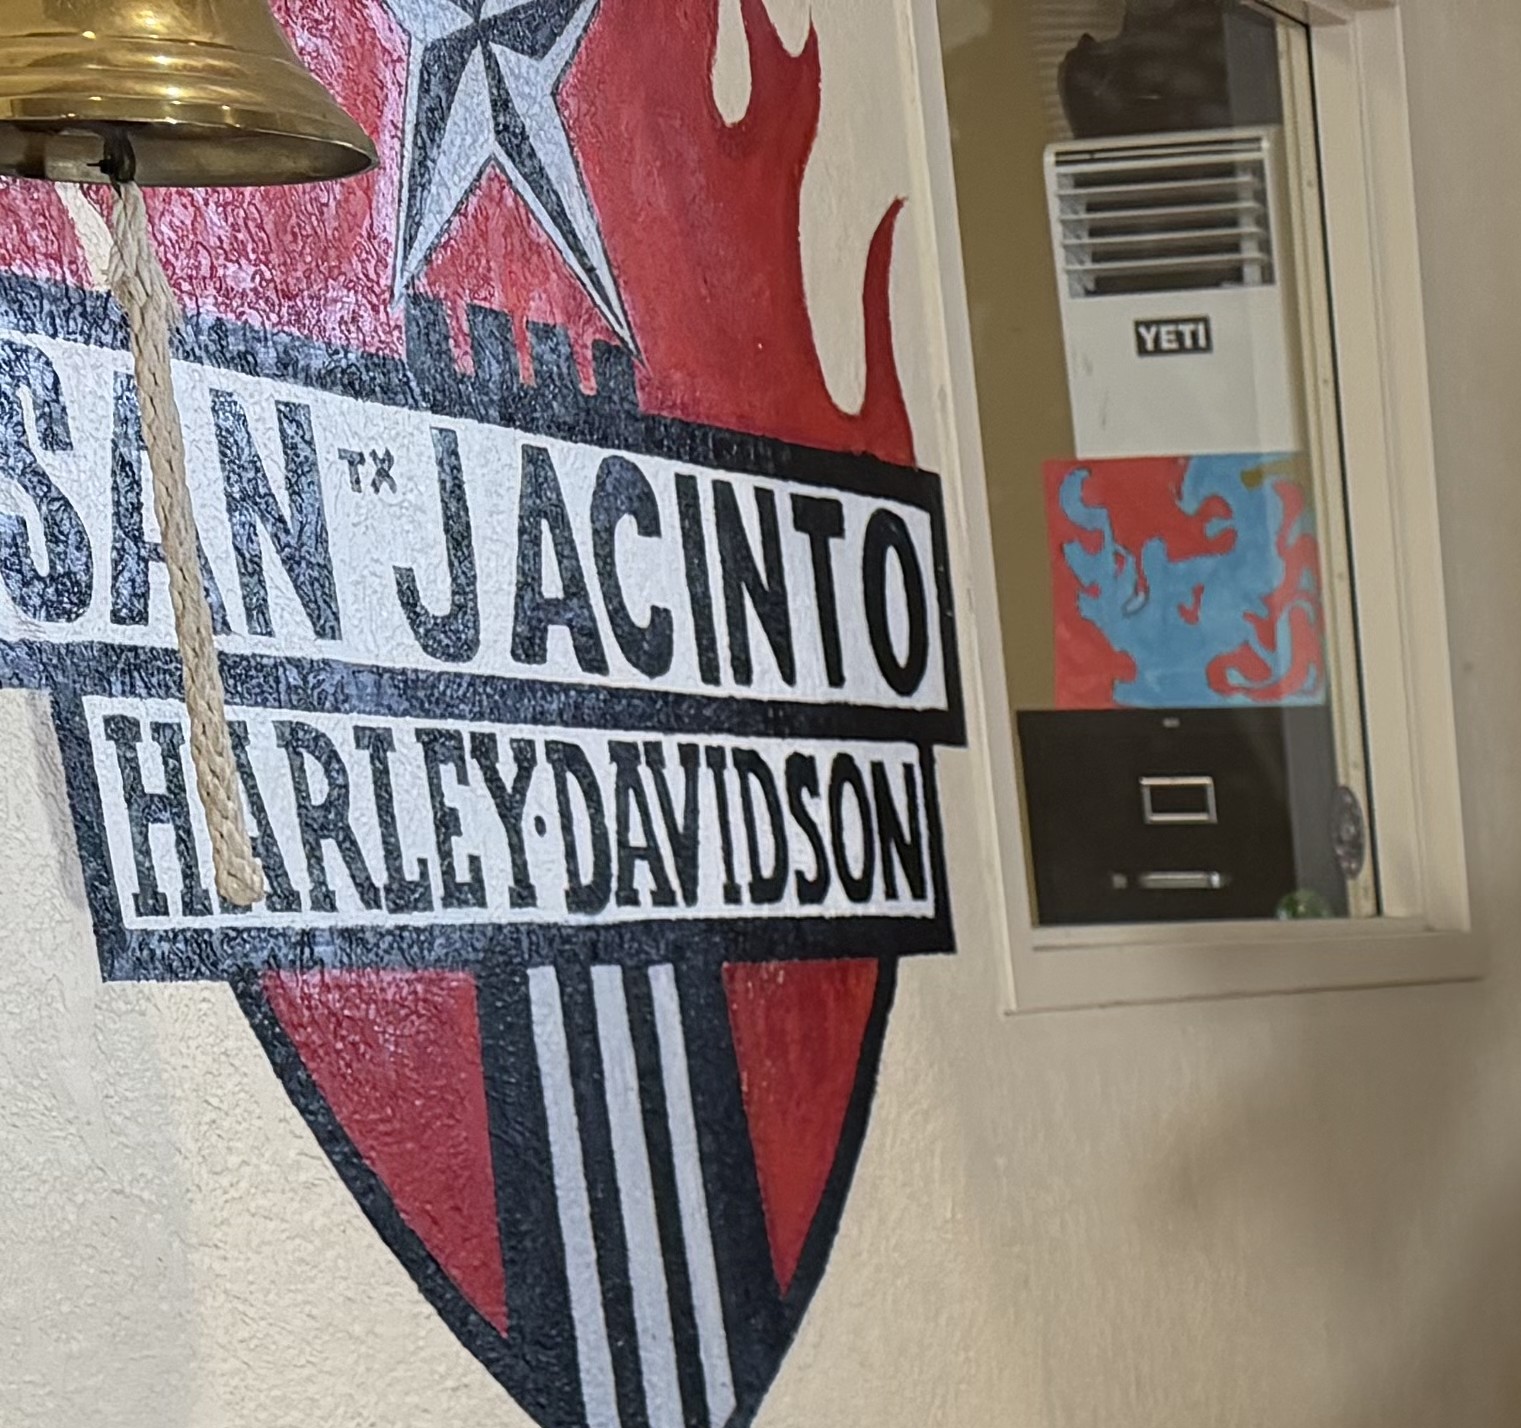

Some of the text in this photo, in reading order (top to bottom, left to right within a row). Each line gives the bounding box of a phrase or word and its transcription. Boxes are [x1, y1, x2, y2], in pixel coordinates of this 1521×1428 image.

[1138, 320, 1207, 352] YETI
[337, 446, 399, 495] TX
[0, 339, 931, 697] SAN JACINTO
